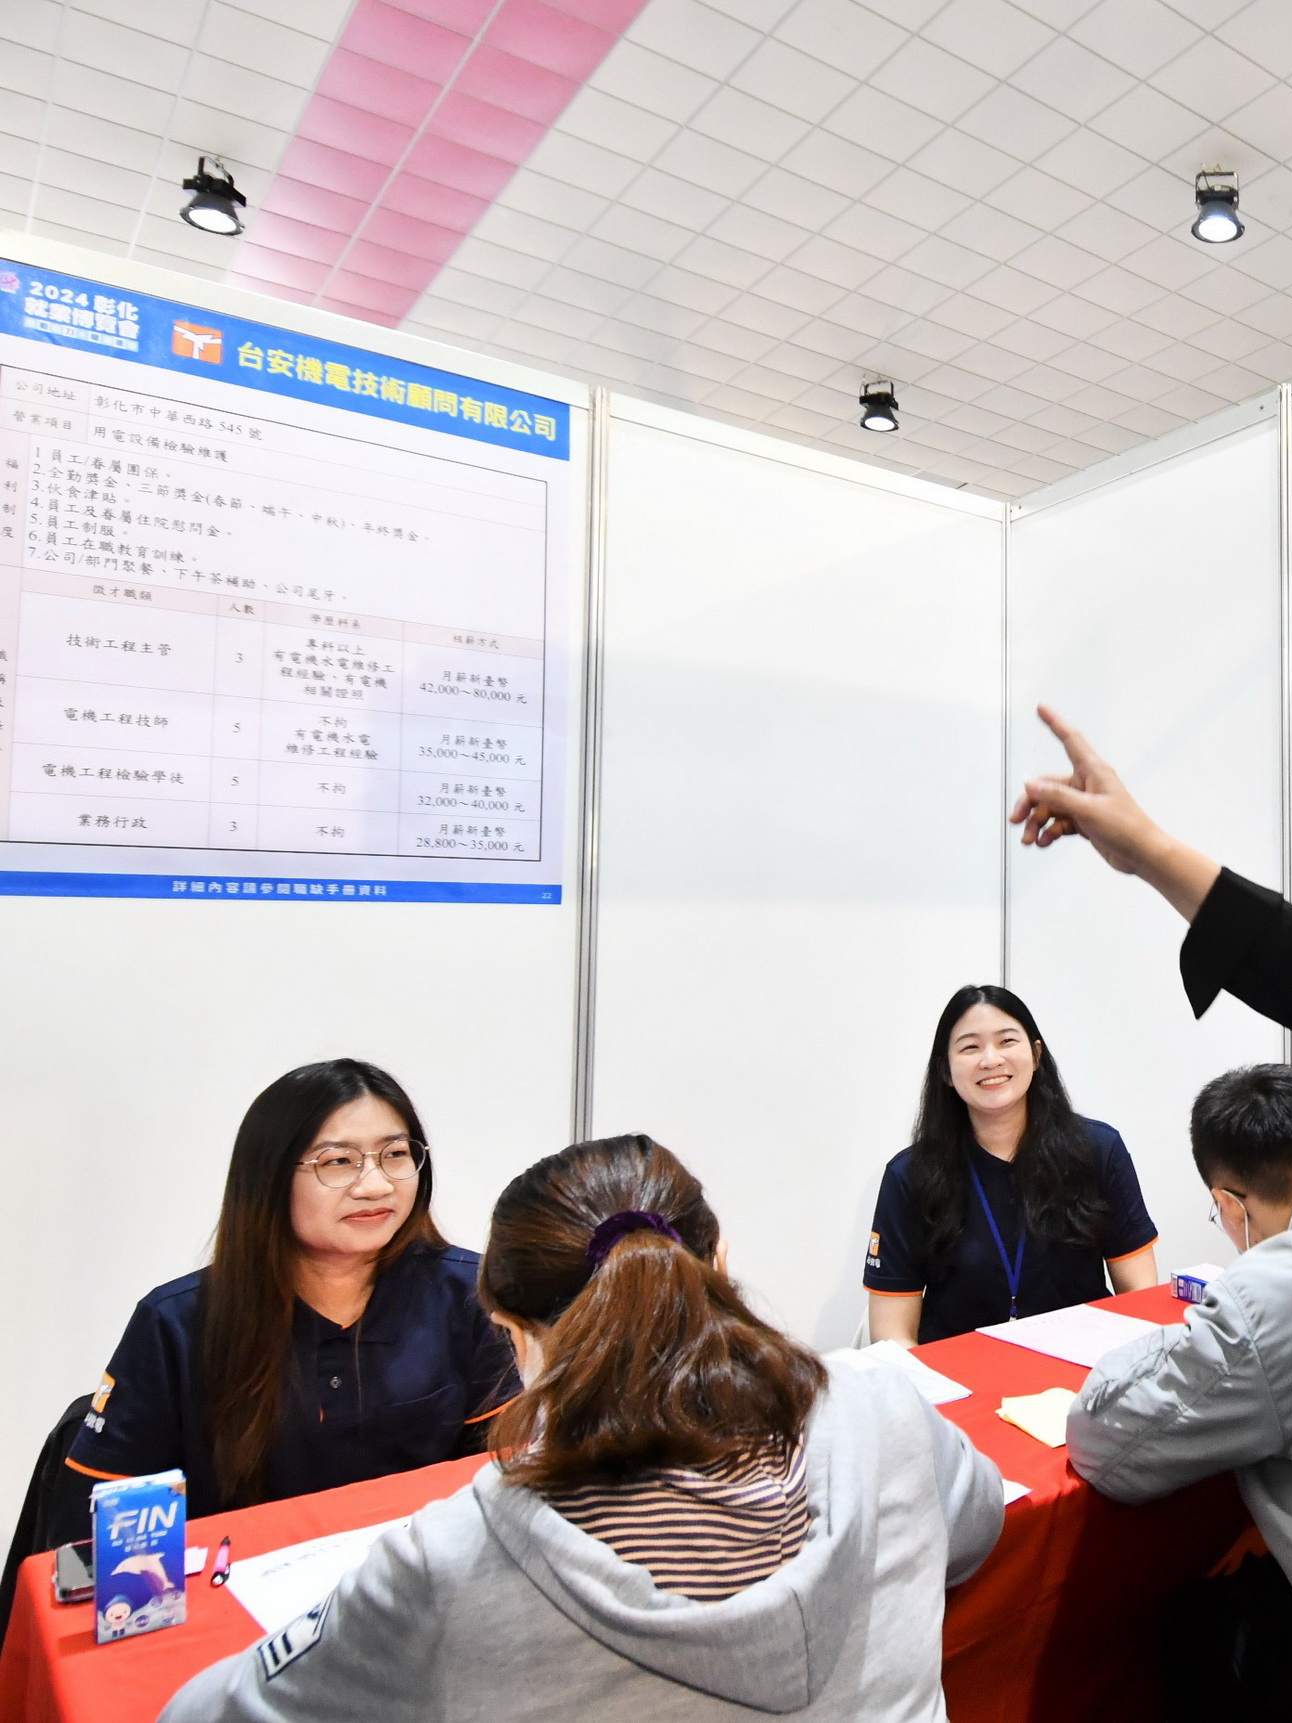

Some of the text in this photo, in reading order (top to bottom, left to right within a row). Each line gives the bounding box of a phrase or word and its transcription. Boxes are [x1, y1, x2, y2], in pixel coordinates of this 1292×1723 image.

[29, 280, 139, 321] 2024 彰化
[15, 380, 77, 402] 公司地址
[236, 340, 557, 441] 台安機電技術顧問有限公司
[12, 409, 73, 431] 營業項目
[93, 425, 230, 463] 用電設備檢驗維護
[65, 632, 245, 665] 技術工程主管 3
[62, 706, 242, 735] 電機工程技師 5
[318, 715, 349, 730] 不拘
[41, 762, 347, 796] 電機工程檢驗學徒 5 不拘
[76, 812, 346, 839] 業務行政 3 不拘
[106, 1500, 179, 1541] FIN
